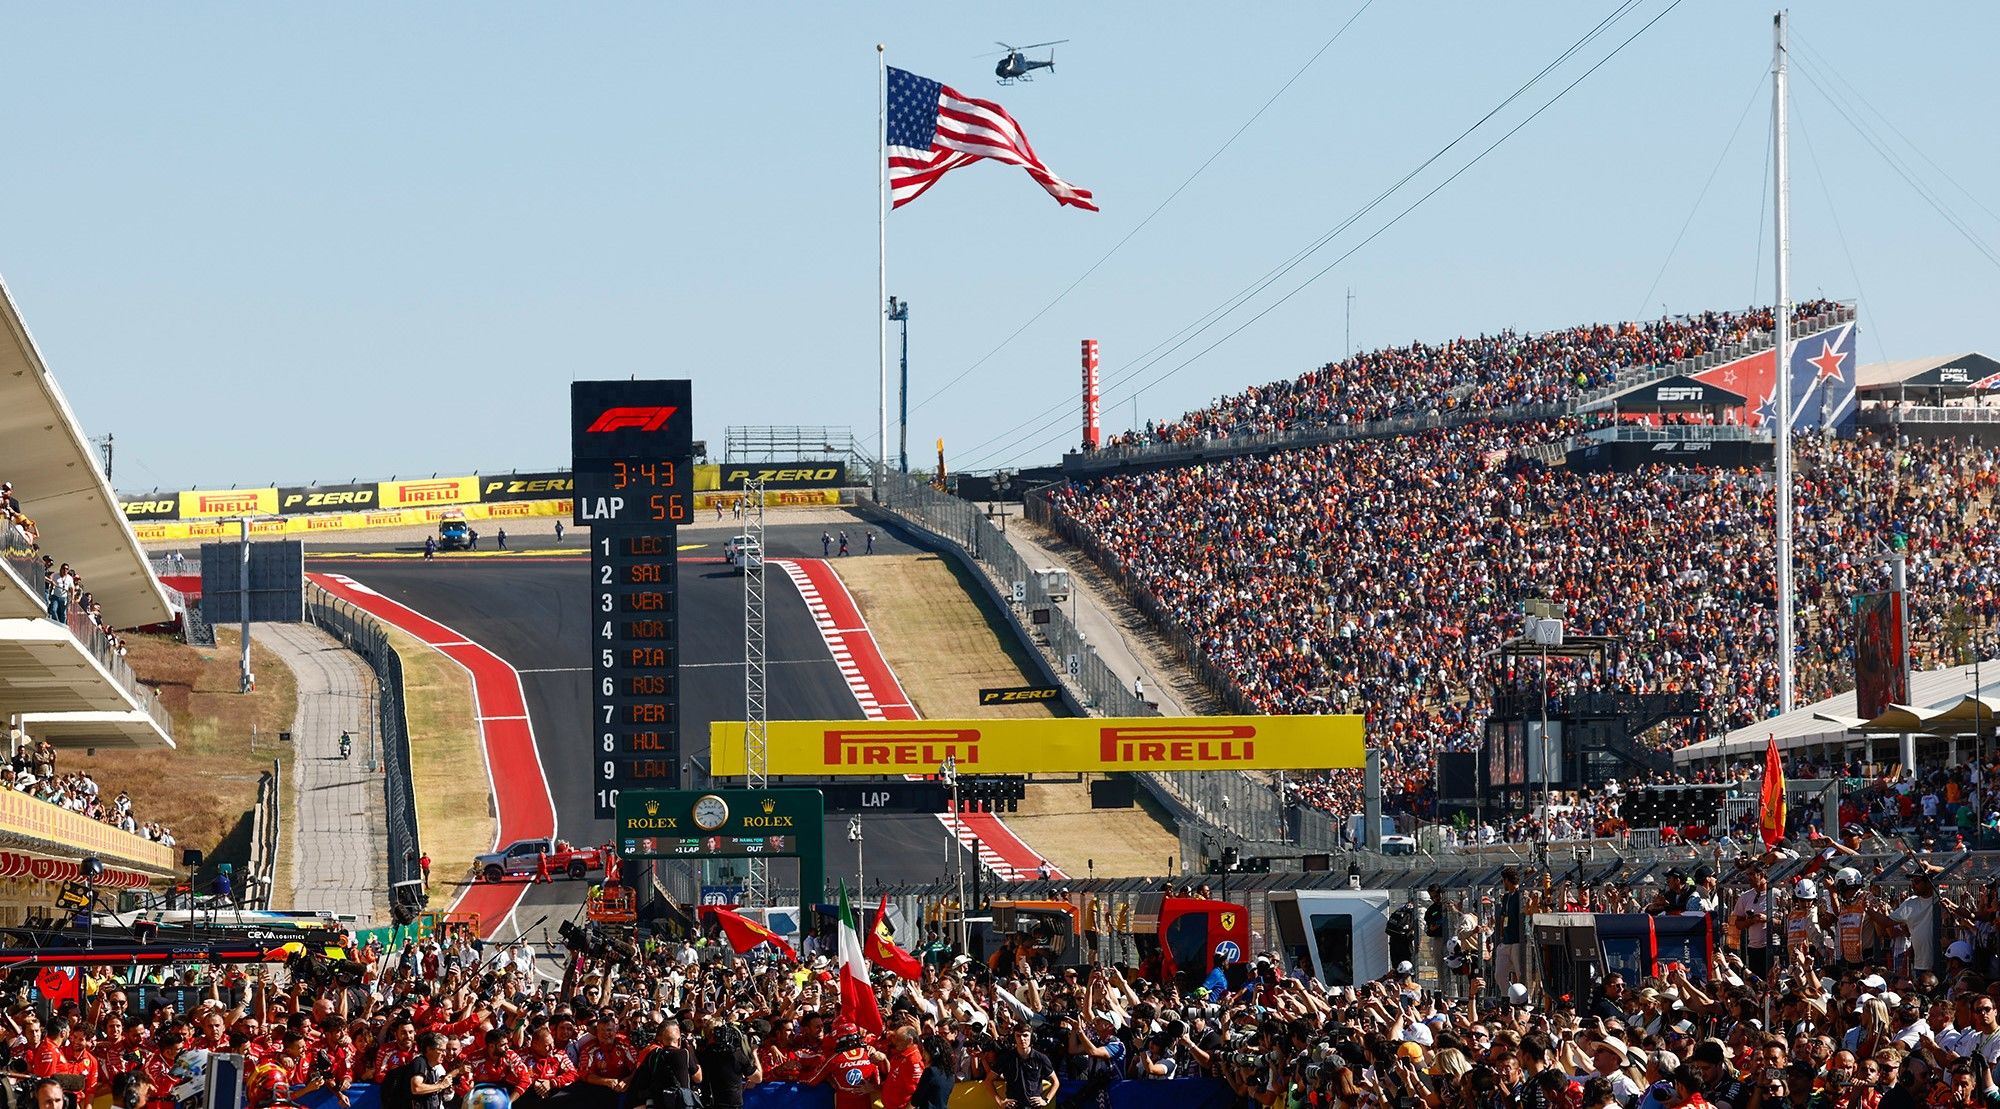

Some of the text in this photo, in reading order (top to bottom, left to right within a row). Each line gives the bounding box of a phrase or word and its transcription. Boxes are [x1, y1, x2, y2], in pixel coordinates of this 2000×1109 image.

[1940, 373, 1974, 382] PSL
[1657, 387, 1703, 400] ESPN
[1683, 442, 1711, 450] ESPN
[614, 462, 674, 488] 3:43
[727, 468, 838, 482] P ZERO
[399, 482, 459, 503] PIRELLI
[485, 479, 573, 495] P ZER
[199, 493, 258, 513] PIRELLI
[284, 490, 373, 507] P ZERO
[488, 503, 530, 516] PIRELLI
[581, 496, 625, 520] LAP
[650, 495, 684, 520] 56
[248, 520, 284, 532] PIRELLI
[307, 516, 342, 529] PIRELLI
[366, 512, 402, 525] PIRELLI
[189, 523, 225, 535] PIRELLI
[601, 536, 662, 556] 1 LEC
[601, 565, 661, 585] 2 SAI
[601, 592, 664, 612] 3 VER
[601, 621, 665, 640] 4 NOR
[602, 647, 665, 668] 5 PIA
[1070, 656, 1078, 674] 100
[602, 676, 665, 696] 6 RUS
[983, 689, 1058, 702] P ZERO
[603, 704, 665, 724] 7 PER
[603, 732, 665, 752] 8 HUL
[823, 728, 981, 765] PIRELLI
[1100, 725, 1257, 762] PIRELLI
[604, 760, 667, 780] 9 LAW
[861, 791, 891, 808] LAP
[627, 817, 678, 829] ROLEX
[743, 816, 793, 827] ROLEX
[38, 861, 48, 875] 19
[705, 894, 725, 905] FIA
[848, 1069, 861, 1086] hp
